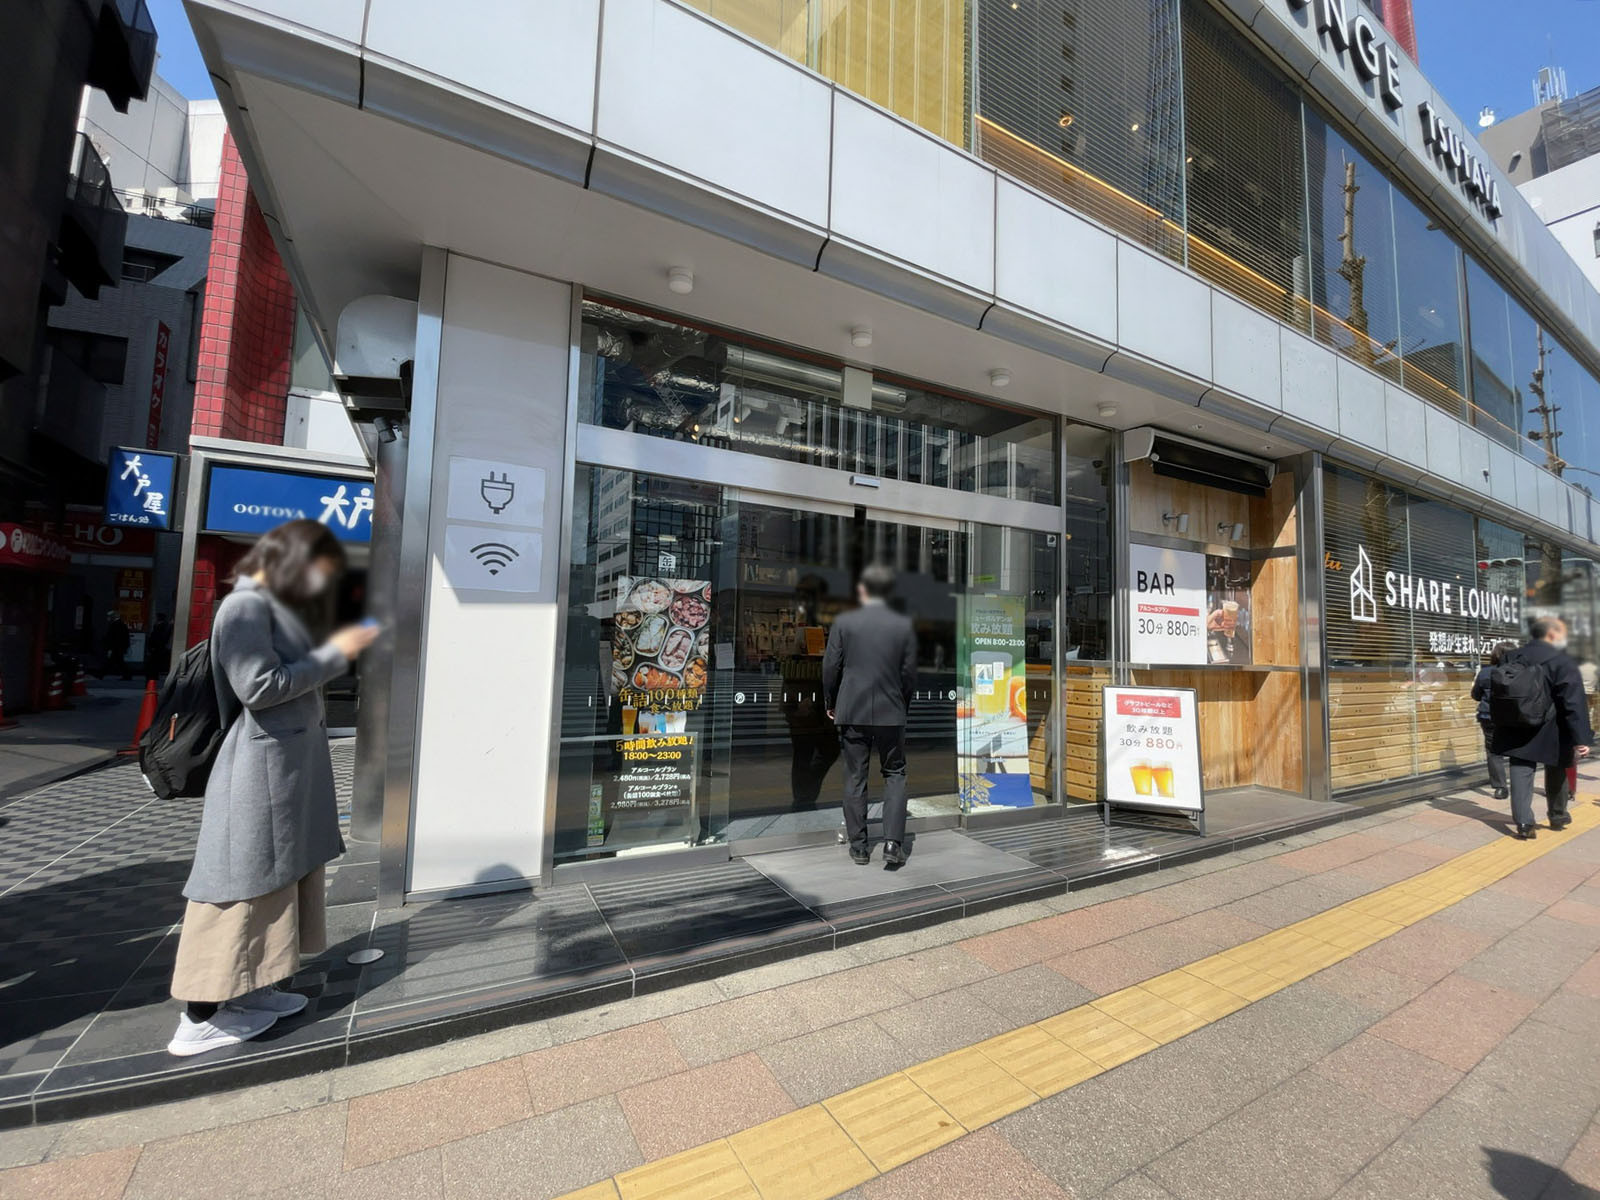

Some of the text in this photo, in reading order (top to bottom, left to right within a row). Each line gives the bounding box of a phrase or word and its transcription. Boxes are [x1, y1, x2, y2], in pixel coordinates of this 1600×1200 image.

[1302, 0, 1503, 218] NGE TSUTAYA
[121, 454, 166, 515] 大戸屋
[233, 485, 374, 529] OOTOYA 大戸
[1137, 570, 1175, 596] BAR
[1385, 570, 1519, 624] SHARE LOUNGE
[1138, 618, 1164, 635] 30分
[1429, 631, 1520, 655] 発想が生まれ、シェア
[1119, 737, 1141, 747] 30分
[1126, 723, 1173, 736] 飲み放題
[631, 766, 677, 774] アルコールプラン
